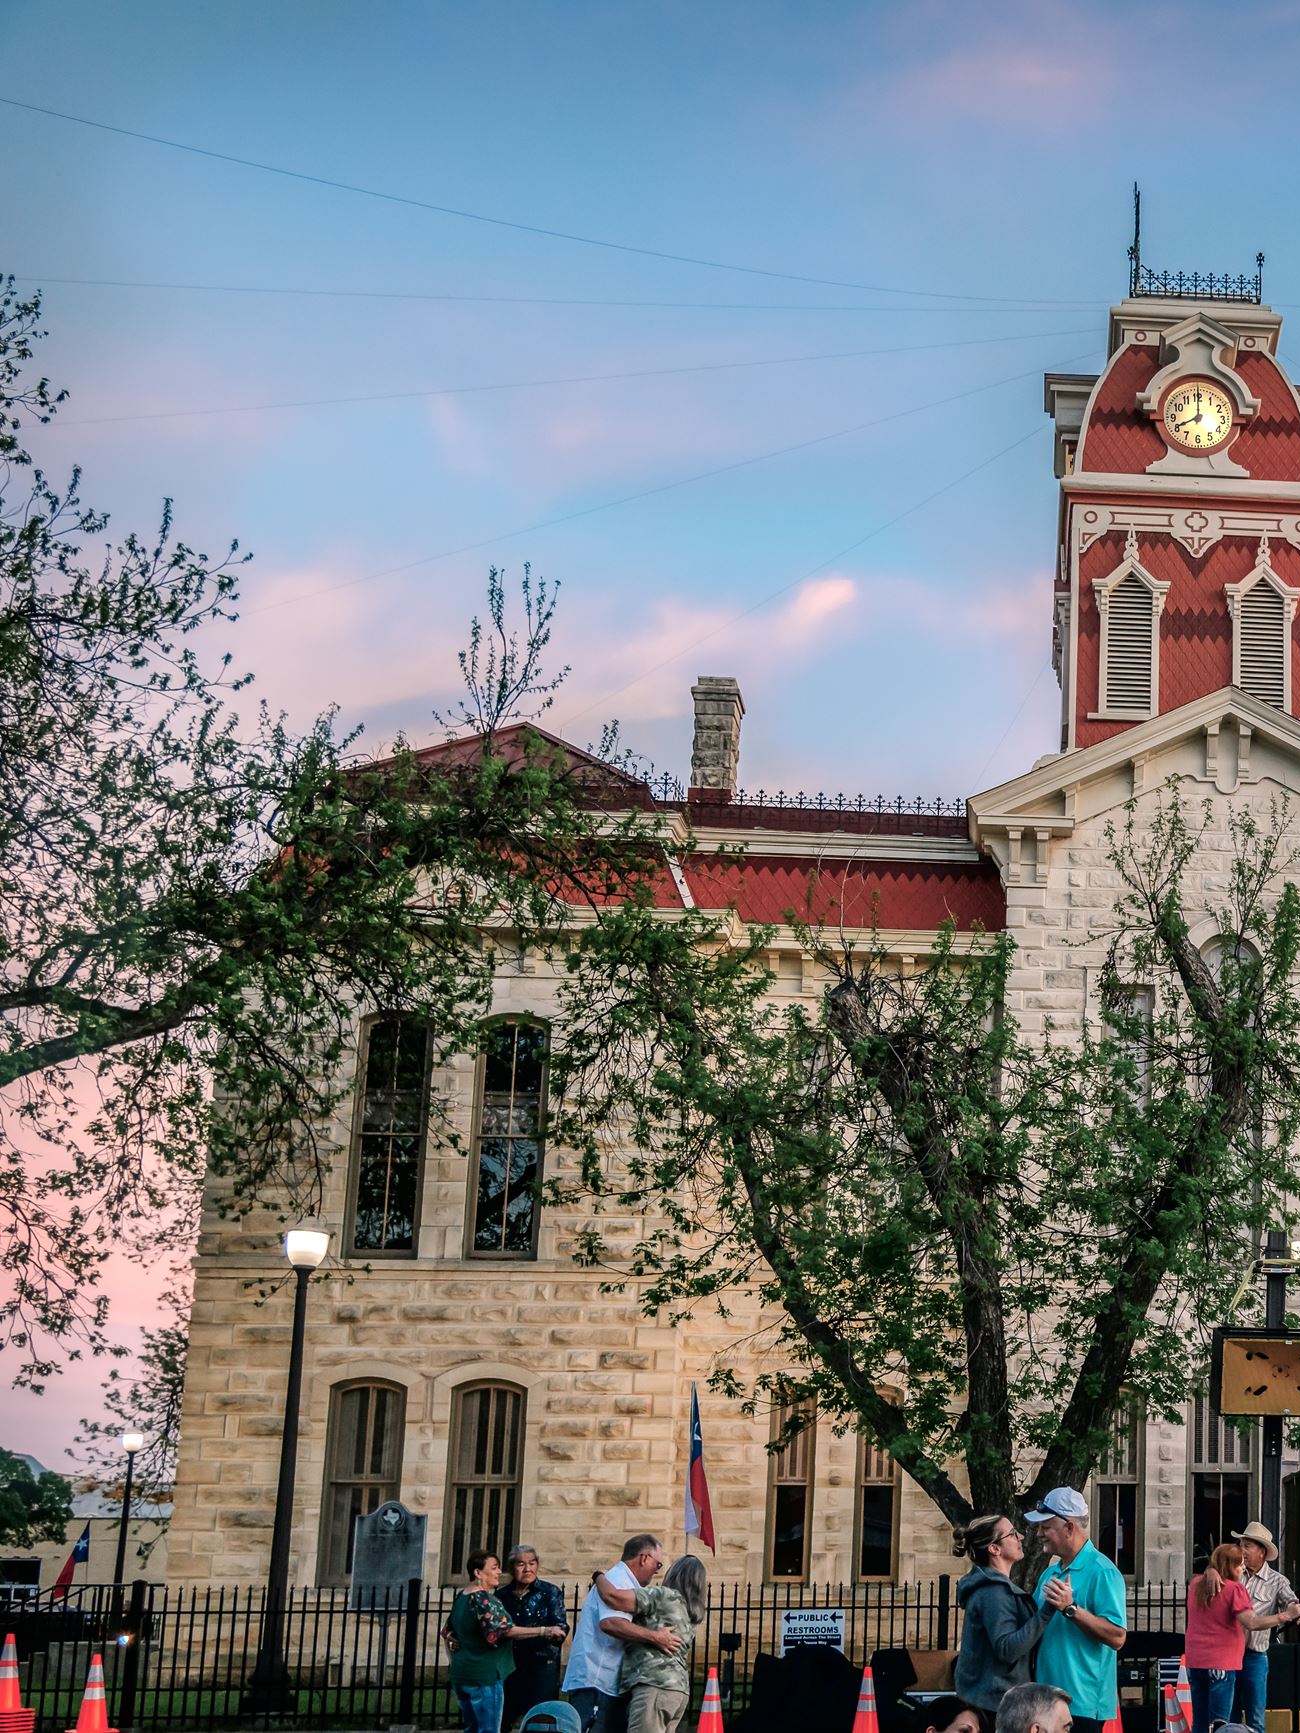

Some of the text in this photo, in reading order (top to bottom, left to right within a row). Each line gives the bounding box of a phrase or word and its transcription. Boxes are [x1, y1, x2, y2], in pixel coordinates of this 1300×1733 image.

[1183, 395, 1189, 405] 11
[1193, 393, 1202, 402] 12
[1208, 396, 1212, 406] 1
[1174, 403, 1183, 412] 10
[1216, 404, 1222, 413] 2
[1170, 413, 1176, 422] 9
[1220, 415, 1226, 424] 3
[1174, 423, 1180, 432] 8
[1215, 425, 1221, 434] 4
[1184, 431, 1189, 440] 7
[1195, 435, 1201, 443] 6
[1207, 432, 1213, 441] 5
[787, 1626, 839, 1634] RESTROOMS
